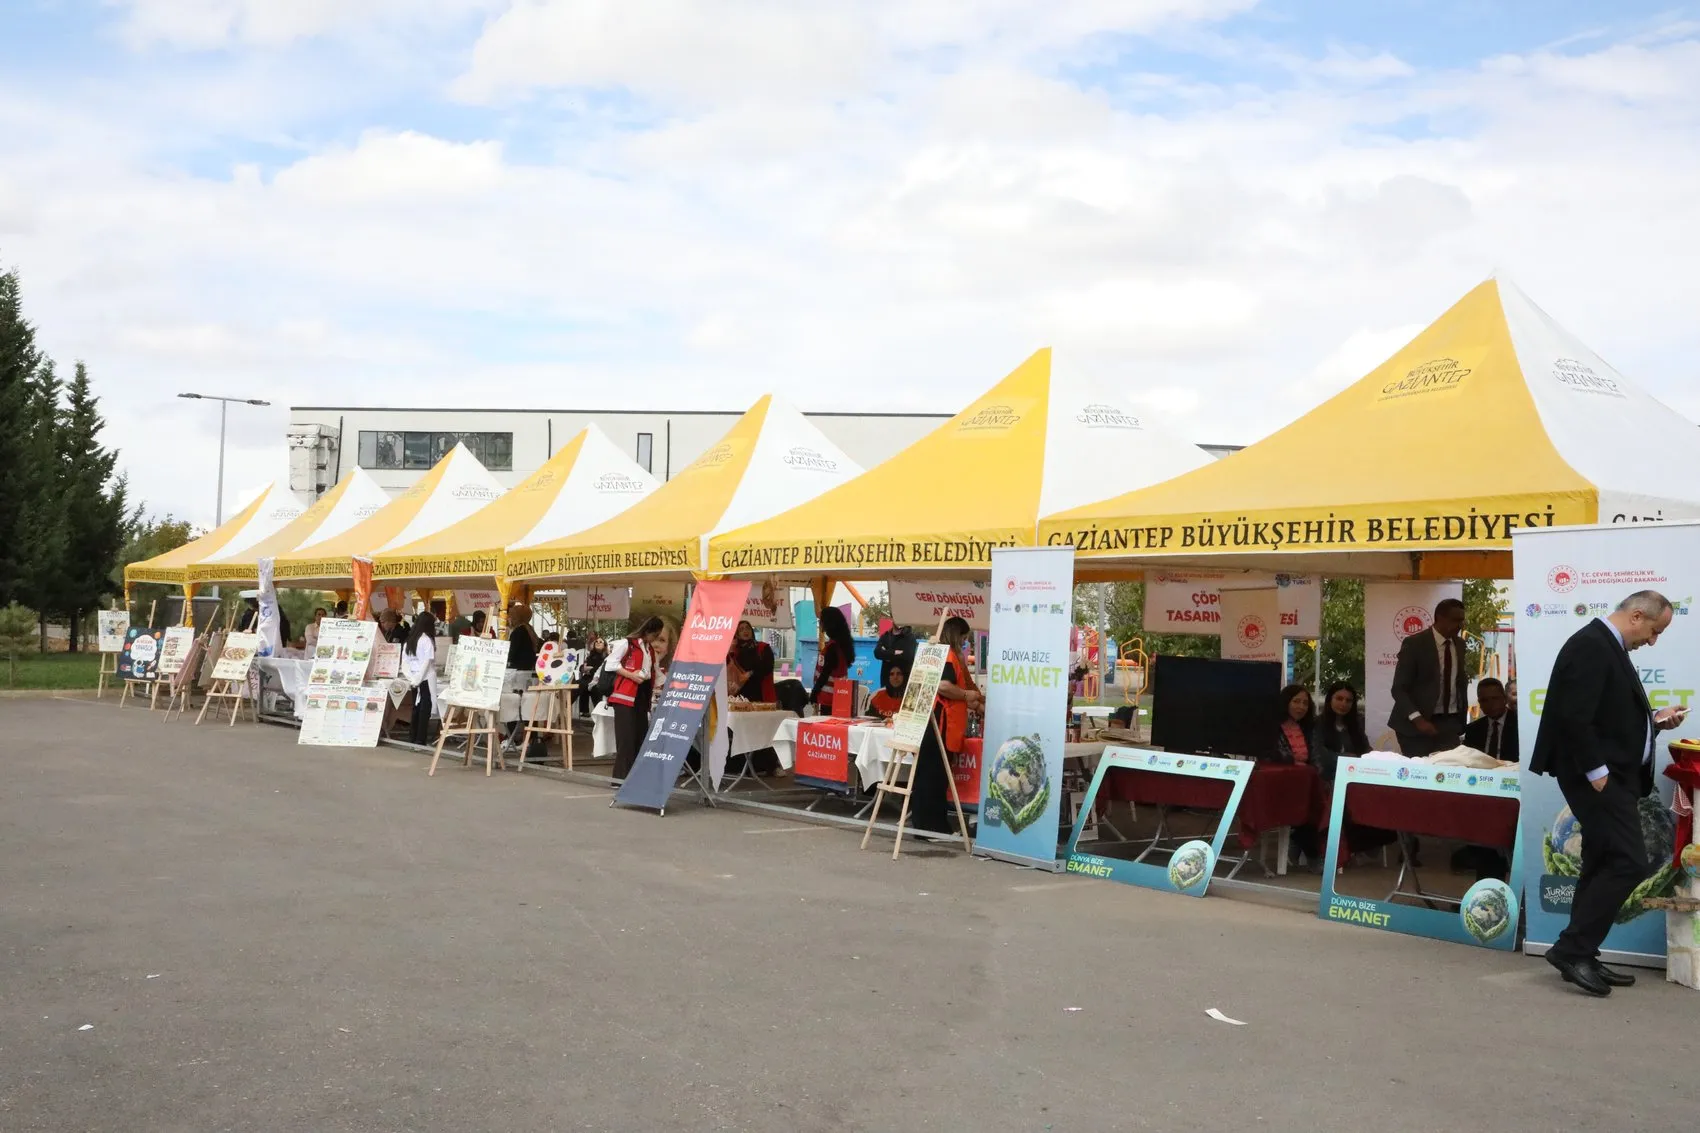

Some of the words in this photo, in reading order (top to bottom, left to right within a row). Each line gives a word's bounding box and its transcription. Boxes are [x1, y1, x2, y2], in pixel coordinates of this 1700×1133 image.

[1048, 523, 1173, 552] GAZİANTEP
[1182, 513, 1357, 551] BÜYÜKŞEHİR
[506, 558, 556, 577] GAZİANTEP
[558, 550, 622, 573] BÜYÜKŞEHİR
[625, 546, 688, 567] BELEDİYESİ
[721, 543, 799, 568] GAZİANTEP
[804, 537, 905, 568] BÜYÜKŞEHİR
[371, 562, 403, 576] AZİANTEP
[404, 558, 451, 576] BÜYÜKŞEHİR
[453, 555, 498, 573] BELEDİYESİ
[915, 590, 936, 602] GERİ
[936, 592, 985, 607] DÖNÜŞÜM
[1191, 591, 1221, 607] ÇÖP
[690, 615, 733, 631] KADEM
[1280, 609, 1299, 626] ESİ
[1002, 648, 1030, 662] DÜNYA
[1031, 650, 1052, 664] BİZE
[991, 663, 1062, 689] EMANET
[1637, 665, 1666, 684] İZE
[803, 731, 842, 751] KADEM
[807, 750, 837, 761] GAZİANTEP
[1070, 854, 1090, 863] DÜNYA
[1066, 860, 1114, 878] EMANET
[1331, 896, 1358, 909] DÜNYA
[1358, 900, 1377, 911] BİZE
[1329, 905, 1391, 927] EMANET
